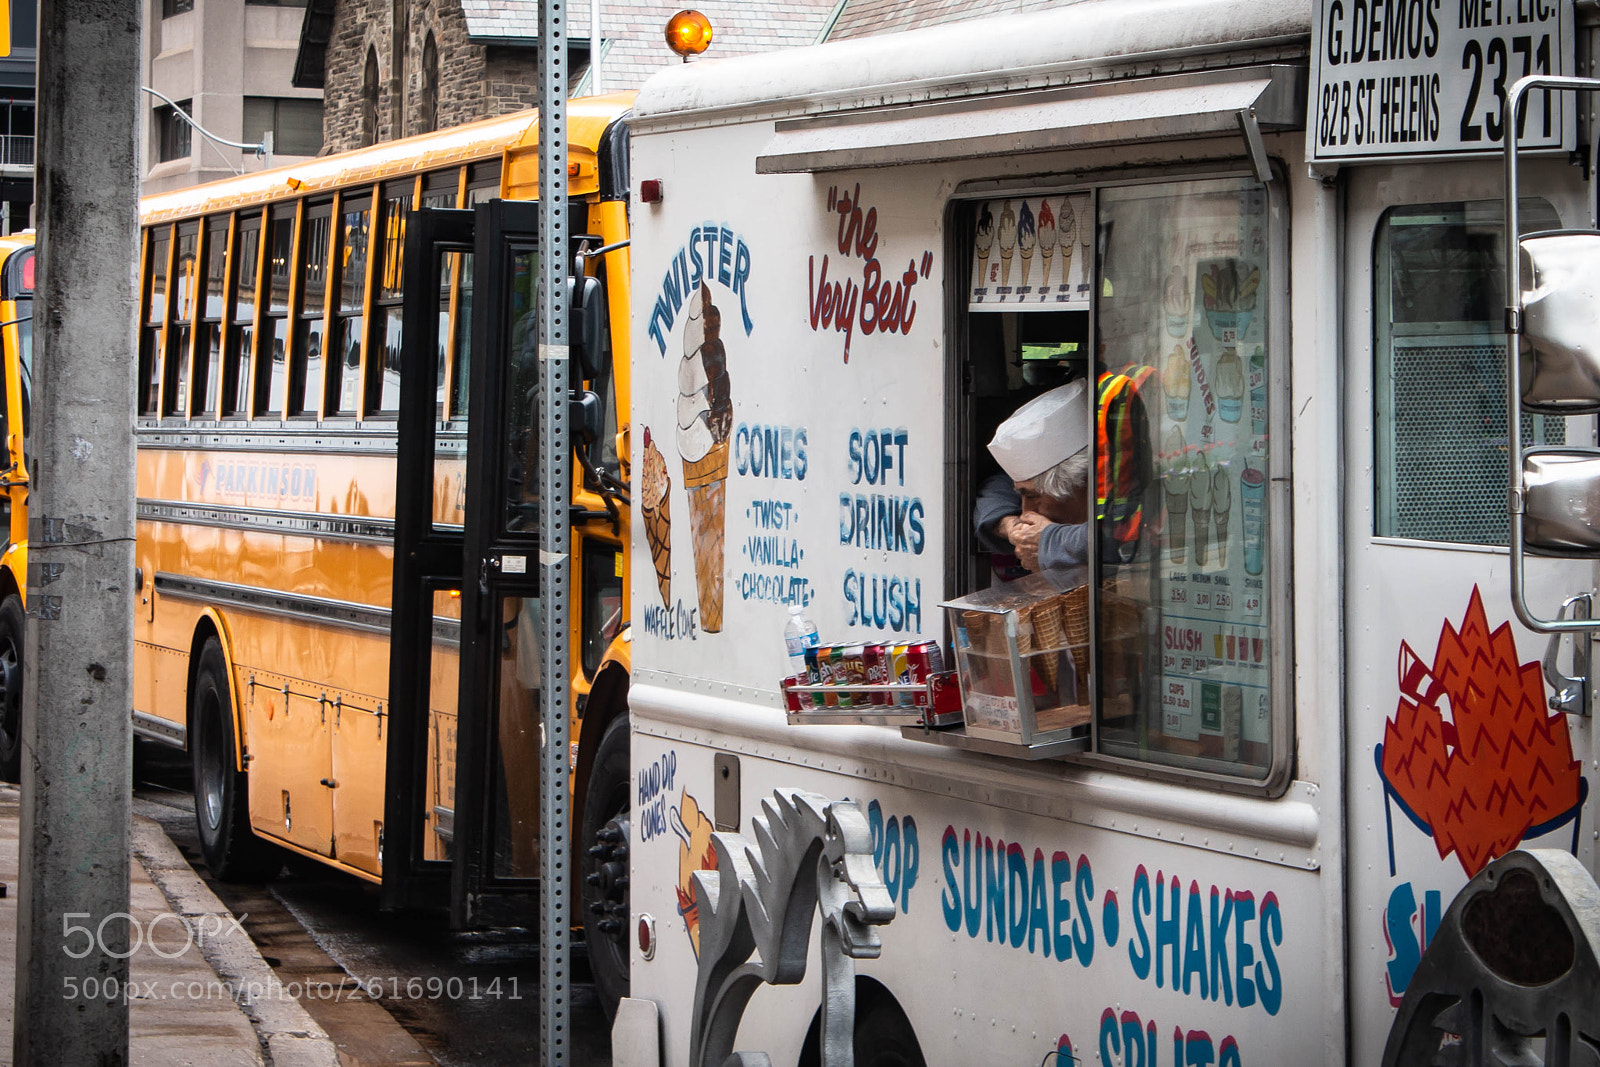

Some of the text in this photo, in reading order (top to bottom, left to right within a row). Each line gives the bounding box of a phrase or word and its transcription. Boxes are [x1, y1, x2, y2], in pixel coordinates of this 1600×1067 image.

[1354, 78, 1376, 146] ST.
[1379, 73, 1440, 144] HELENS
[1459, 34, 1551, 142] 2371
[647, 220, 754, 359] TWISTER
[809, 254, 859, 364] Very
[1186, 336, 1215, 417] SUNDAES
[216, 463, 317, 499] PARKINSON
[735, 421, 808, 481] CONES
[848, 427, 909, 487] SOFT
[839, 491, 926, 555] DRINKS
[643, 603, 675, 641] WAFFLE
[843, 568, 922, 635] SLUSH
[1164, 625, 1203, 652] SLUSH
[638, 750, 677, 806] HAND DIP
[640, 794, 667, 843] CONES
[941, 824, 1095, 968] SUNDAES
[1128, 863, 1283, 1016] SHAKES
